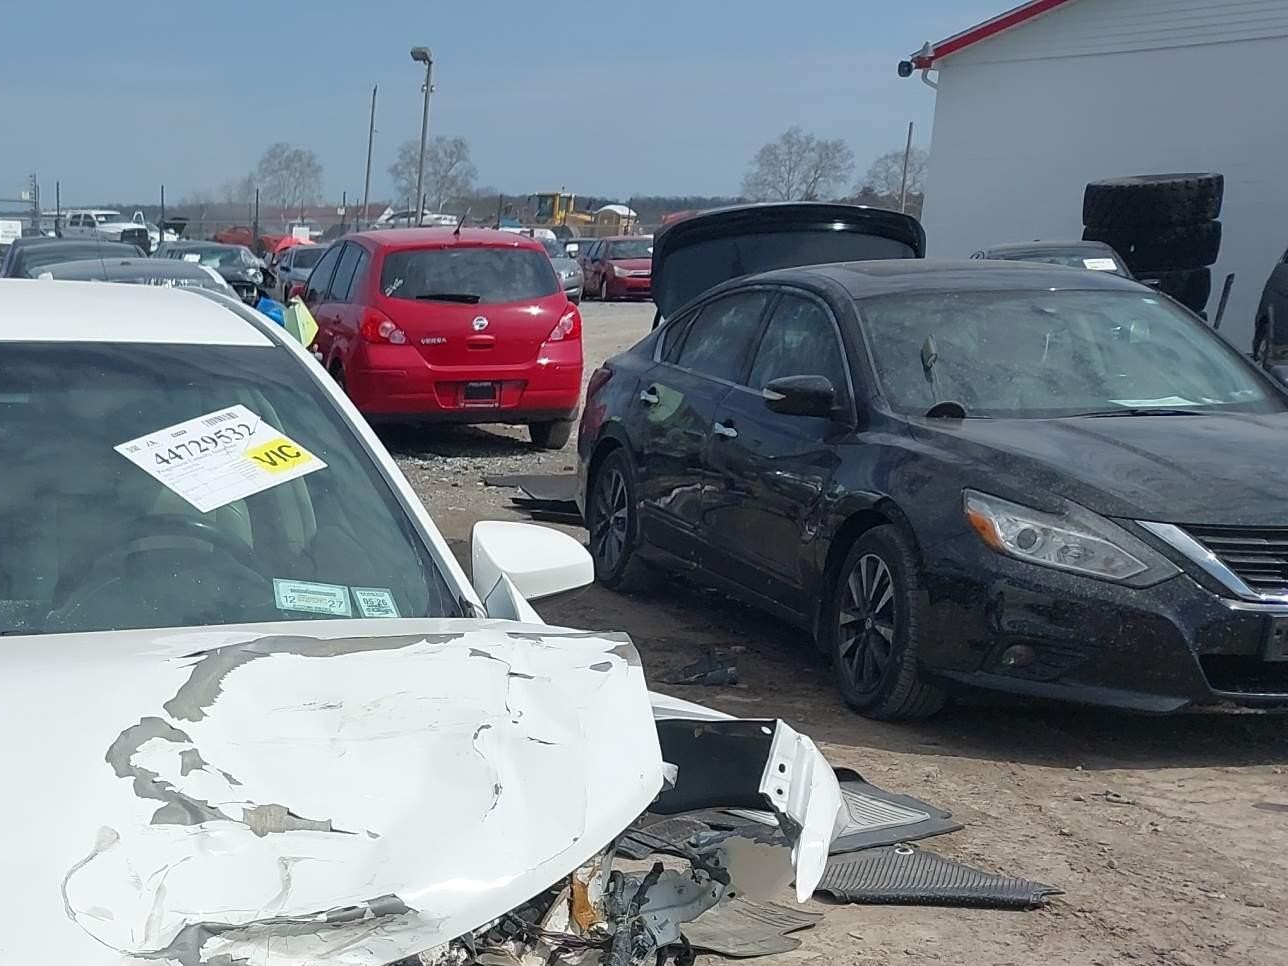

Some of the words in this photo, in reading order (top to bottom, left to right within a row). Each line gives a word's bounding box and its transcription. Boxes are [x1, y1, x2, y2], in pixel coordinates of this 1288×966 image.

[420, 337, 447, 345] VERSA
[154, 423, 256, 466] 44729532
[253, 444, 302, 467] VIC
[282, 595, 296, 604] 12
[328, 600, 343, 608] 27
